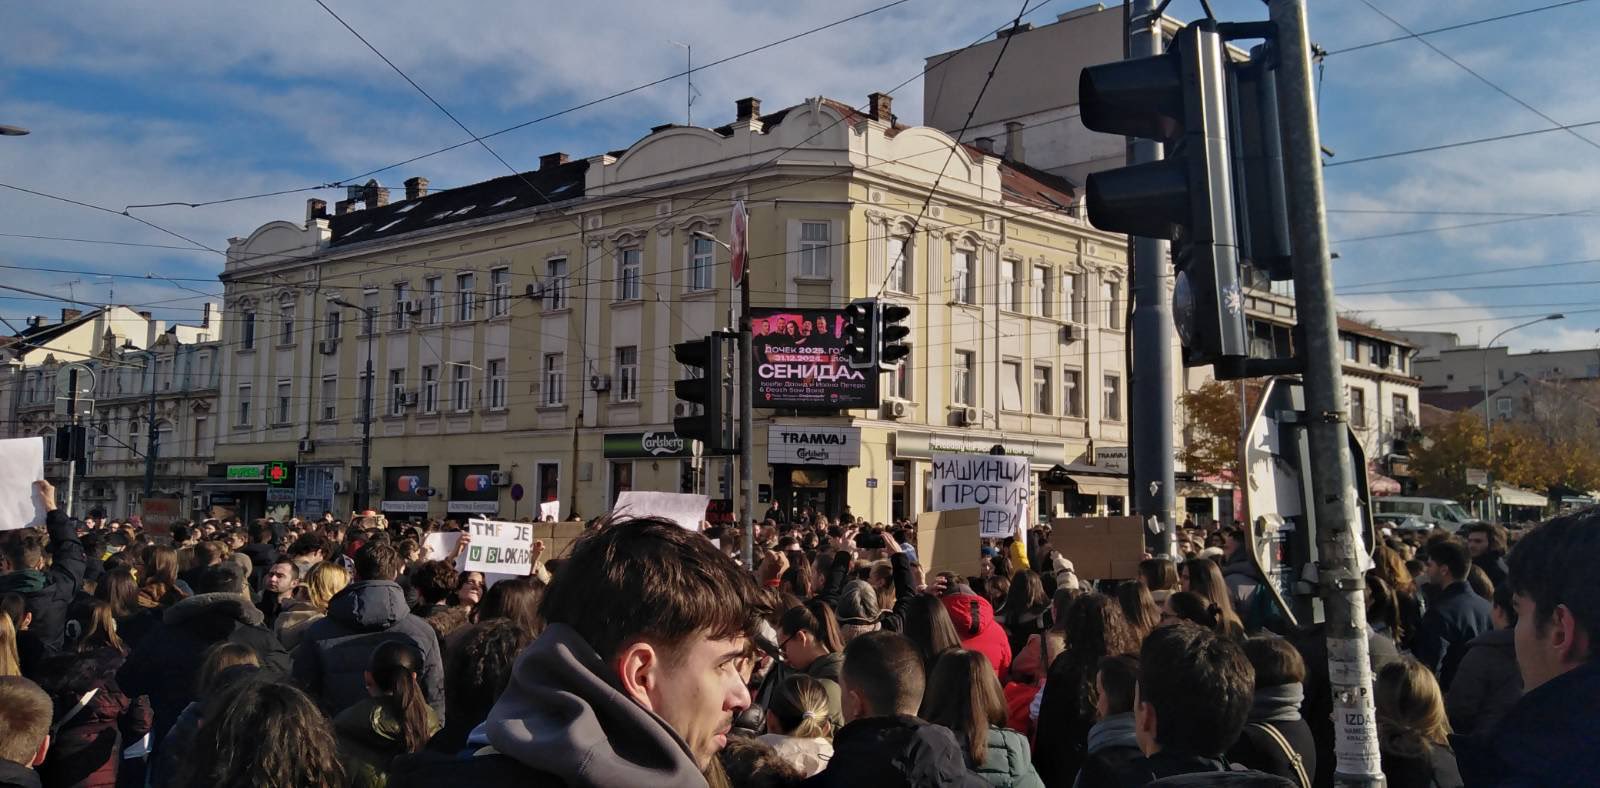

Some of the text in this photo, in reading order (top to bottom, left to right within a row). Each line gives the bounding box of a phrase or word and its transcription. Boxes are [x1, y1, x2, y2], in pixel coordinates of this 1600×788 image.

[798, 346, 826, 354] 2025.
[642, 432, 684, 454] Carlsberg
[781, 432, 847, 445] TRAMVAJ
[797, 448, 829, 460] Carlsberg
[933, 460, 1026, 483] МАШИНЦИ
[942, 484, 1028, 506] ПРОТИВ
[513, 525, 530, 541] JE
